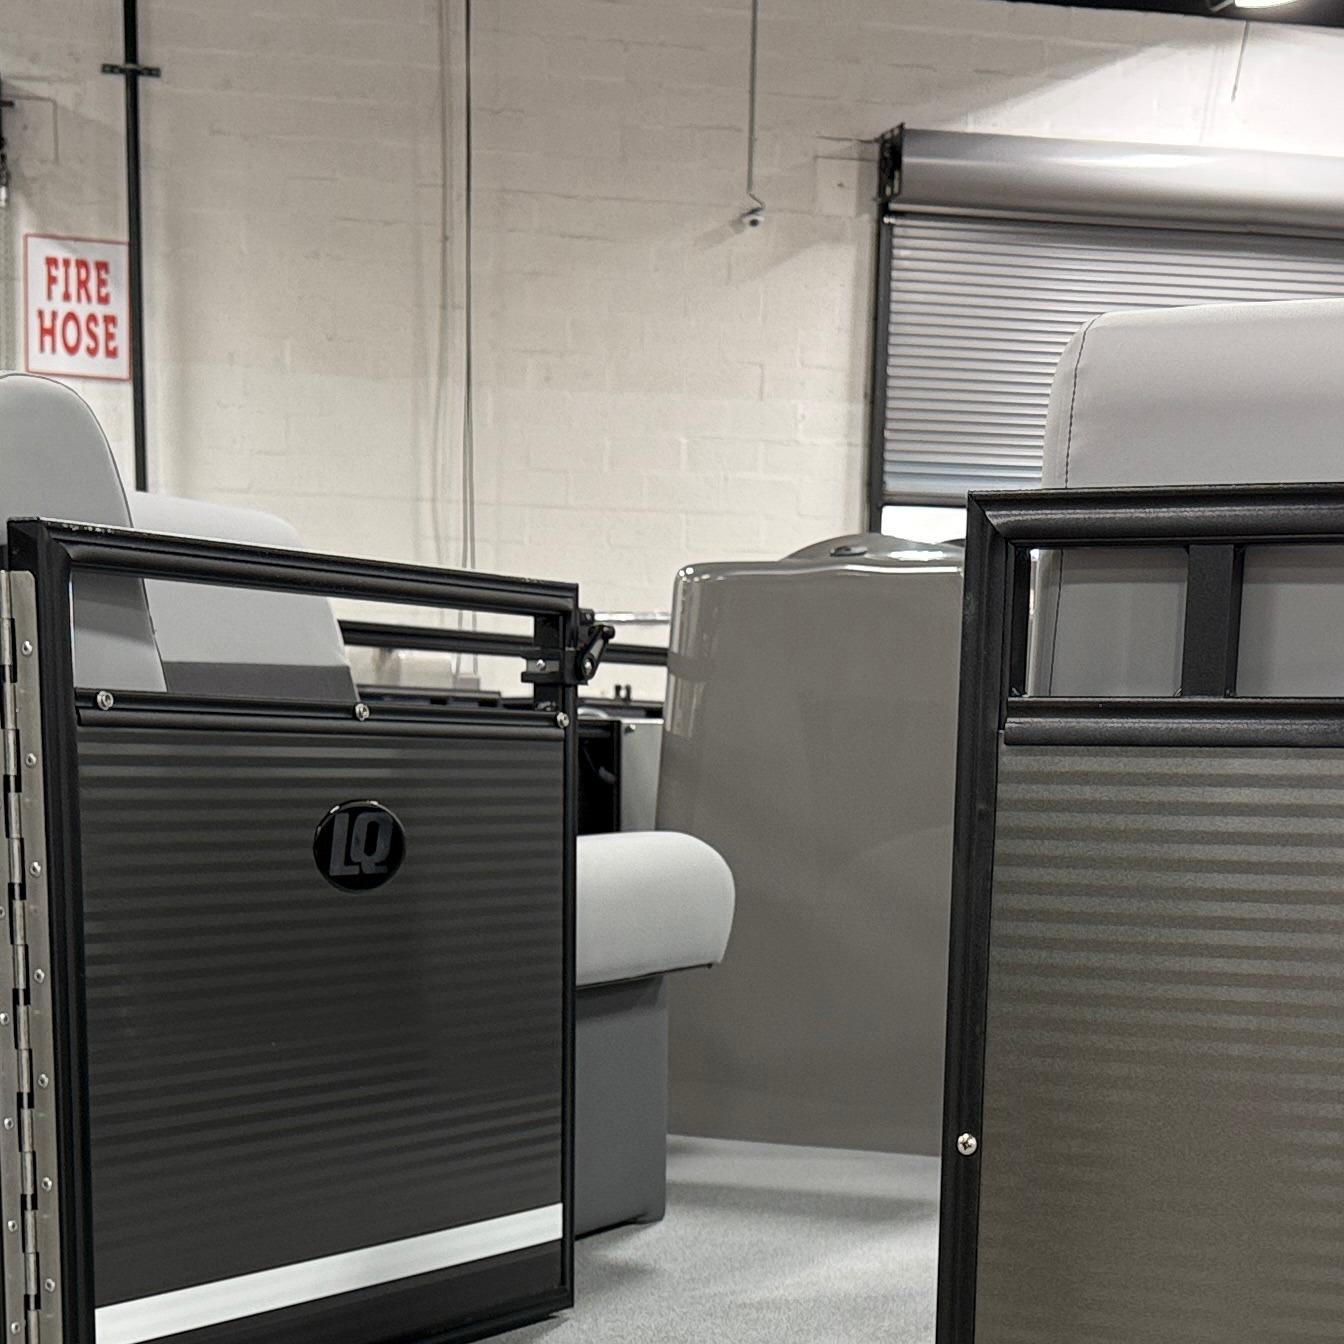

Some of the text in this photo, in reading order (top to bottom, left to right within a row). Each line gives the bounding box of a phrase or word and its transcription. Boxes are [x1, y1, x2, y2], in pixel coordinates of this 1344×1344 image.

[45, 256, 111, 305] FIRE
[37, 309, 118, 359] HOSE
[329, 811, 394, 876] LQ
